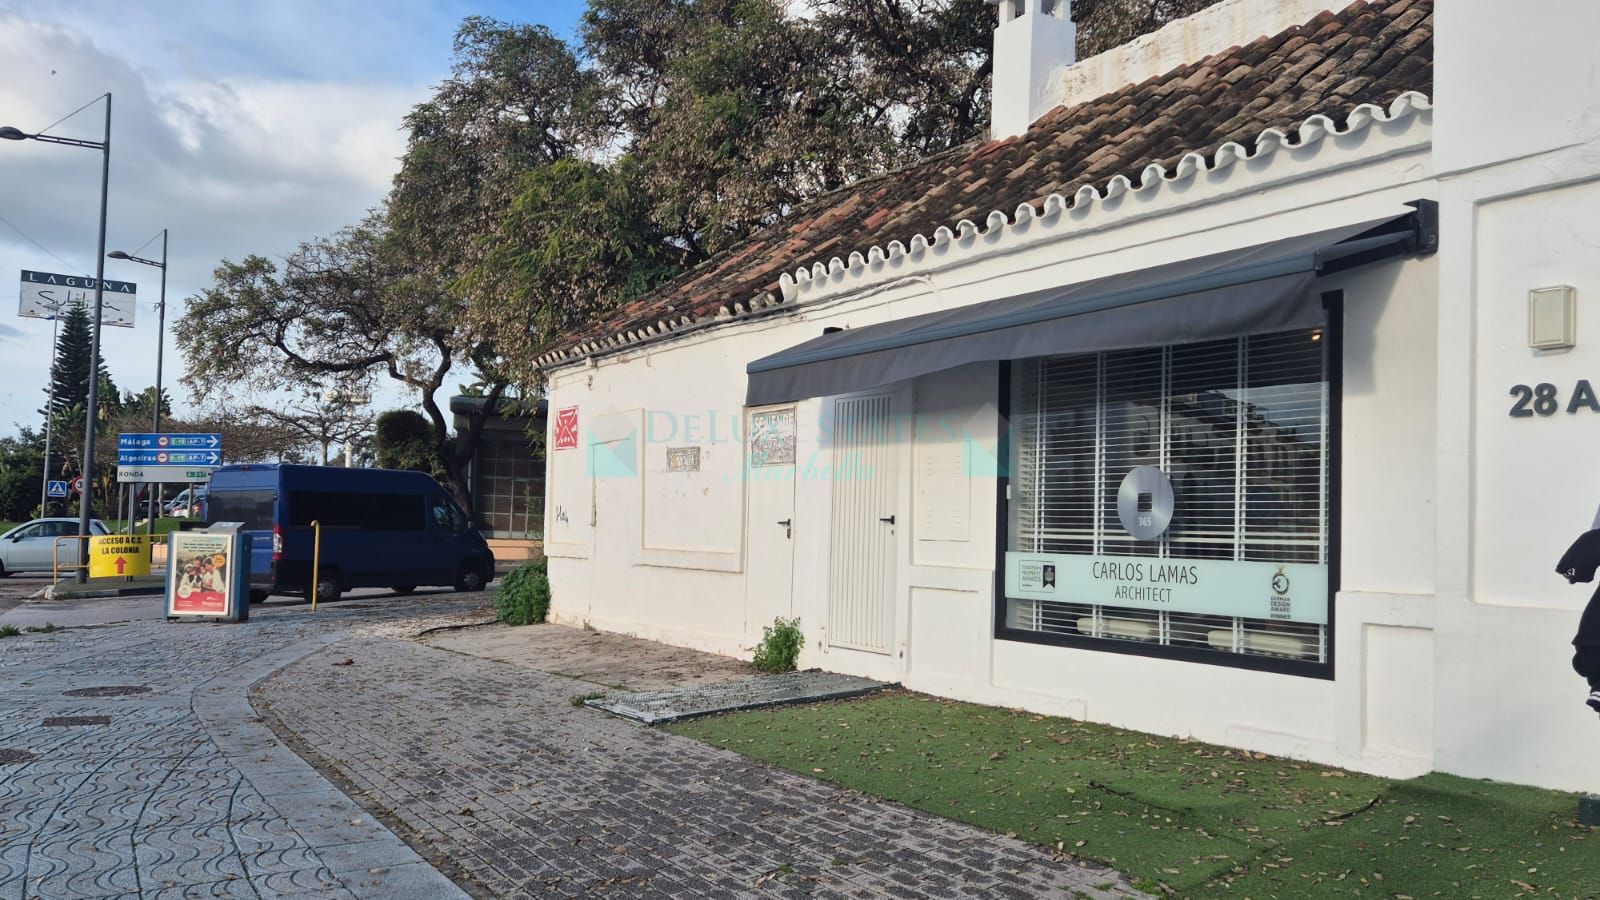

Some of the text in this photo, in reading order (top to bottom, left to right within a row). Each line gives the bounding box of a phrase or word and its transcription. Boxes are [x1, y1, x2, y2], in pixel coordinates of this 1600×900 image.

[29, 272, 130, 293] LAGUNA
[1509, 379, 1600, 418] 28 A
[120, 438, 151, 446] Málaga
[1138, 517, 1152, 527] 365
[98, 536, 124, 545] ACCESO
[125, 536, 130, 544] A
[111, 546, 139, 554] COLONIA
[1092, 561, 1199, 585] CARLOS LAMAS
[1114, 585, 1172, 603] ARCHITECT
